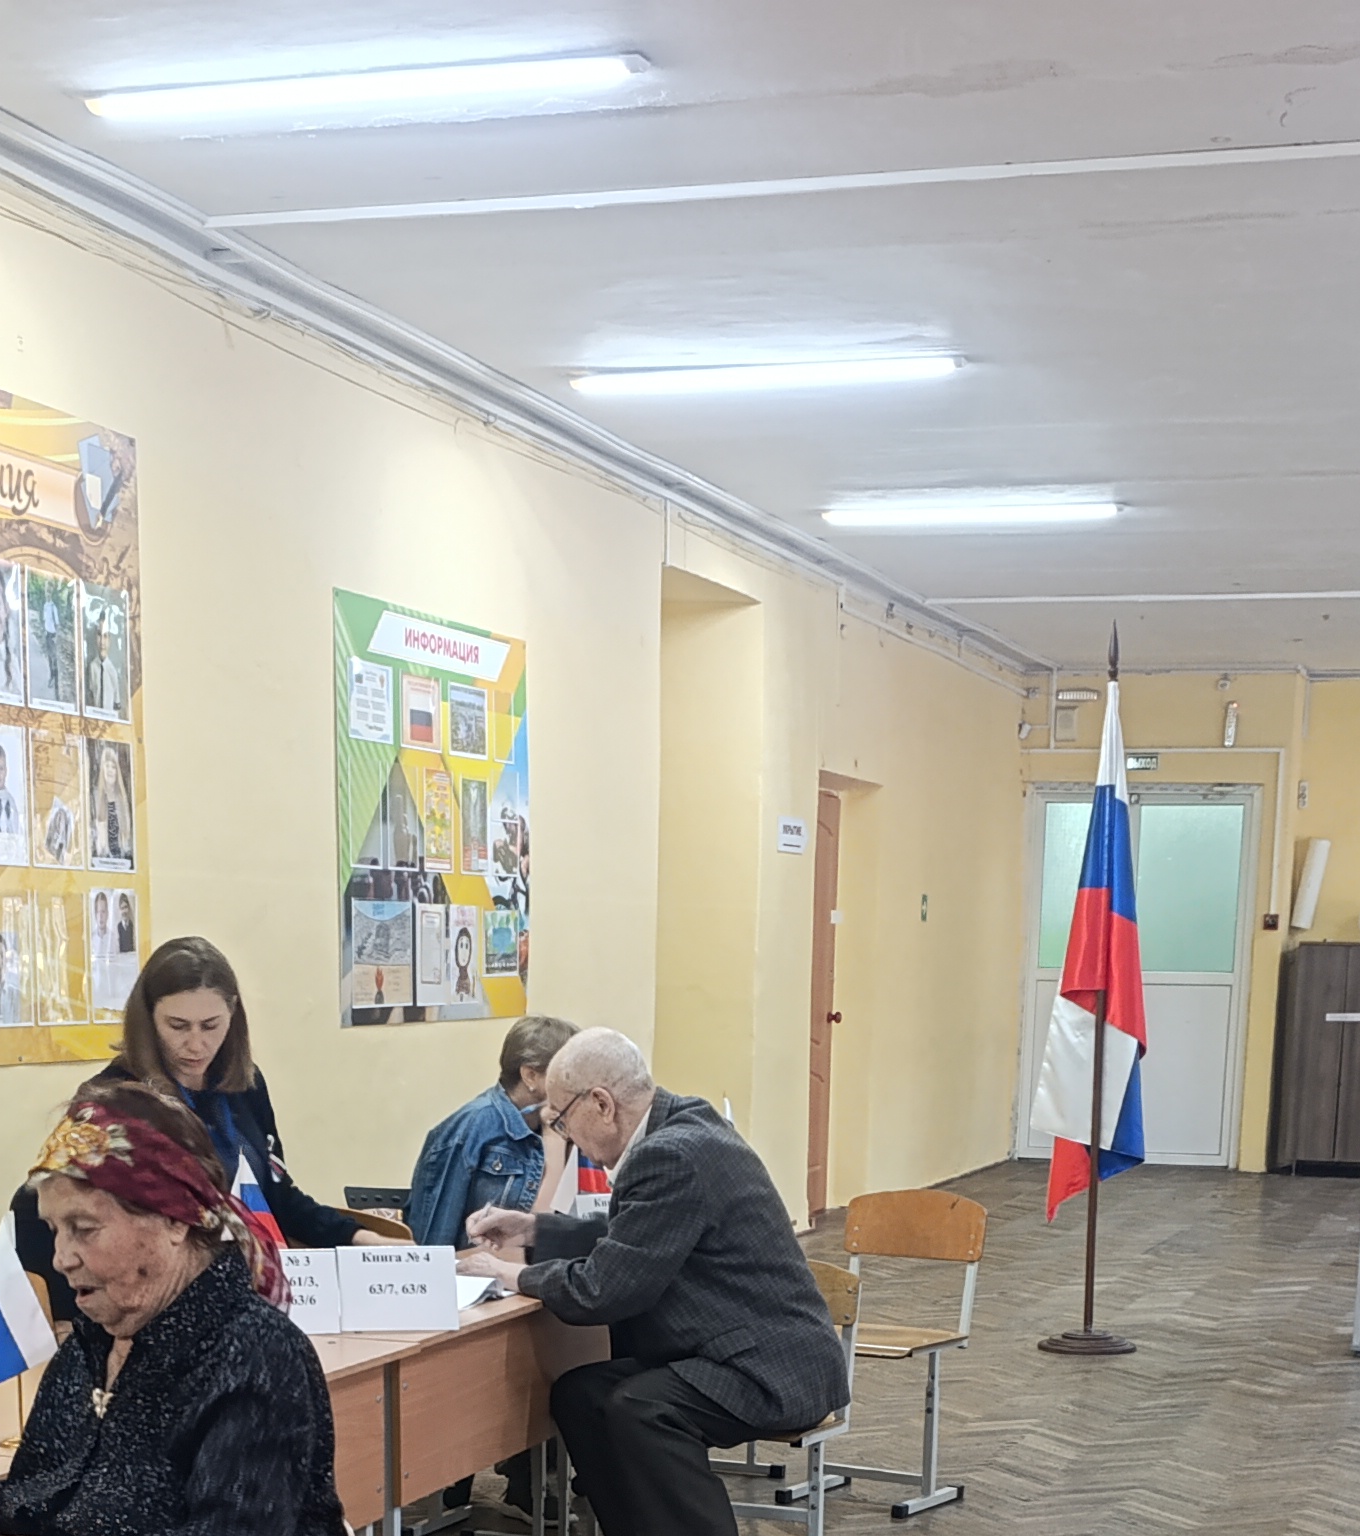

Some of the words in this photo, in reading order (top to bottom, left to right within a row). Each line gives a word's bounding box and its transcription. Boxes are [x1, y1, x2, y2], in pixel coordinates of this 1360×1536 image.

[404, 627, 480, 665] ИНФОРМАЦИЯ
[1127, 757, 1157, 769] ЫХОД
[285, 1256, 300, 1267] №
[303, 1256, 311, 1267] 3
[361, 1252, 402, 1263] Книга
[405, 1252, 420, 1263] №
[423, 1252, 431, 1262] 4
[289, 1276, 319, 1288] 61/3,
[368, 1284, 400, 1296] 63/7,
[401, 1283, 428, 1295] 63/8
